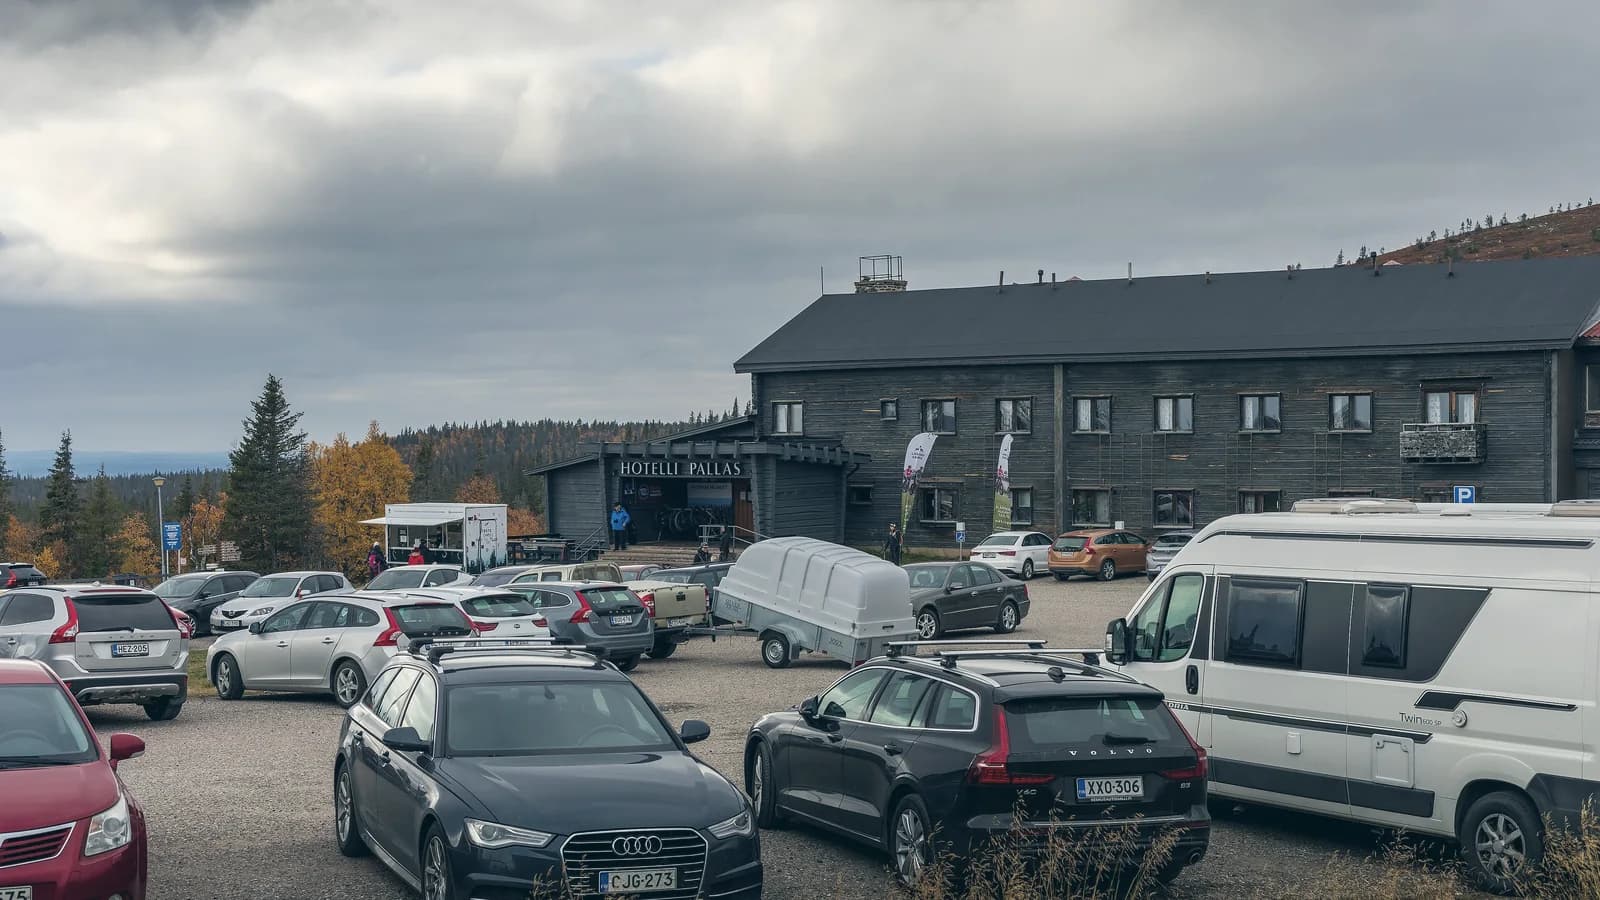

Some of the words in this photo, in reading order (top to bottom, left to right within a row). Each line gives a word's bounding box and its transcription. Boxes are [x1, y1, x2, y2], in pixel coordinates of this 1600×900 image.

[621, 462, 678, 475] HOTELLI
[690, 462, 742, 476] PALLAS
[1458, 488, 1472, 503] P
[1399, 712, 1423, 725] Twin
[1069, 748, 1152, 756] VOLVO
[1087, 780, 1140, 795] XXO-306
[611, 872, 673, 889] CJG-273
